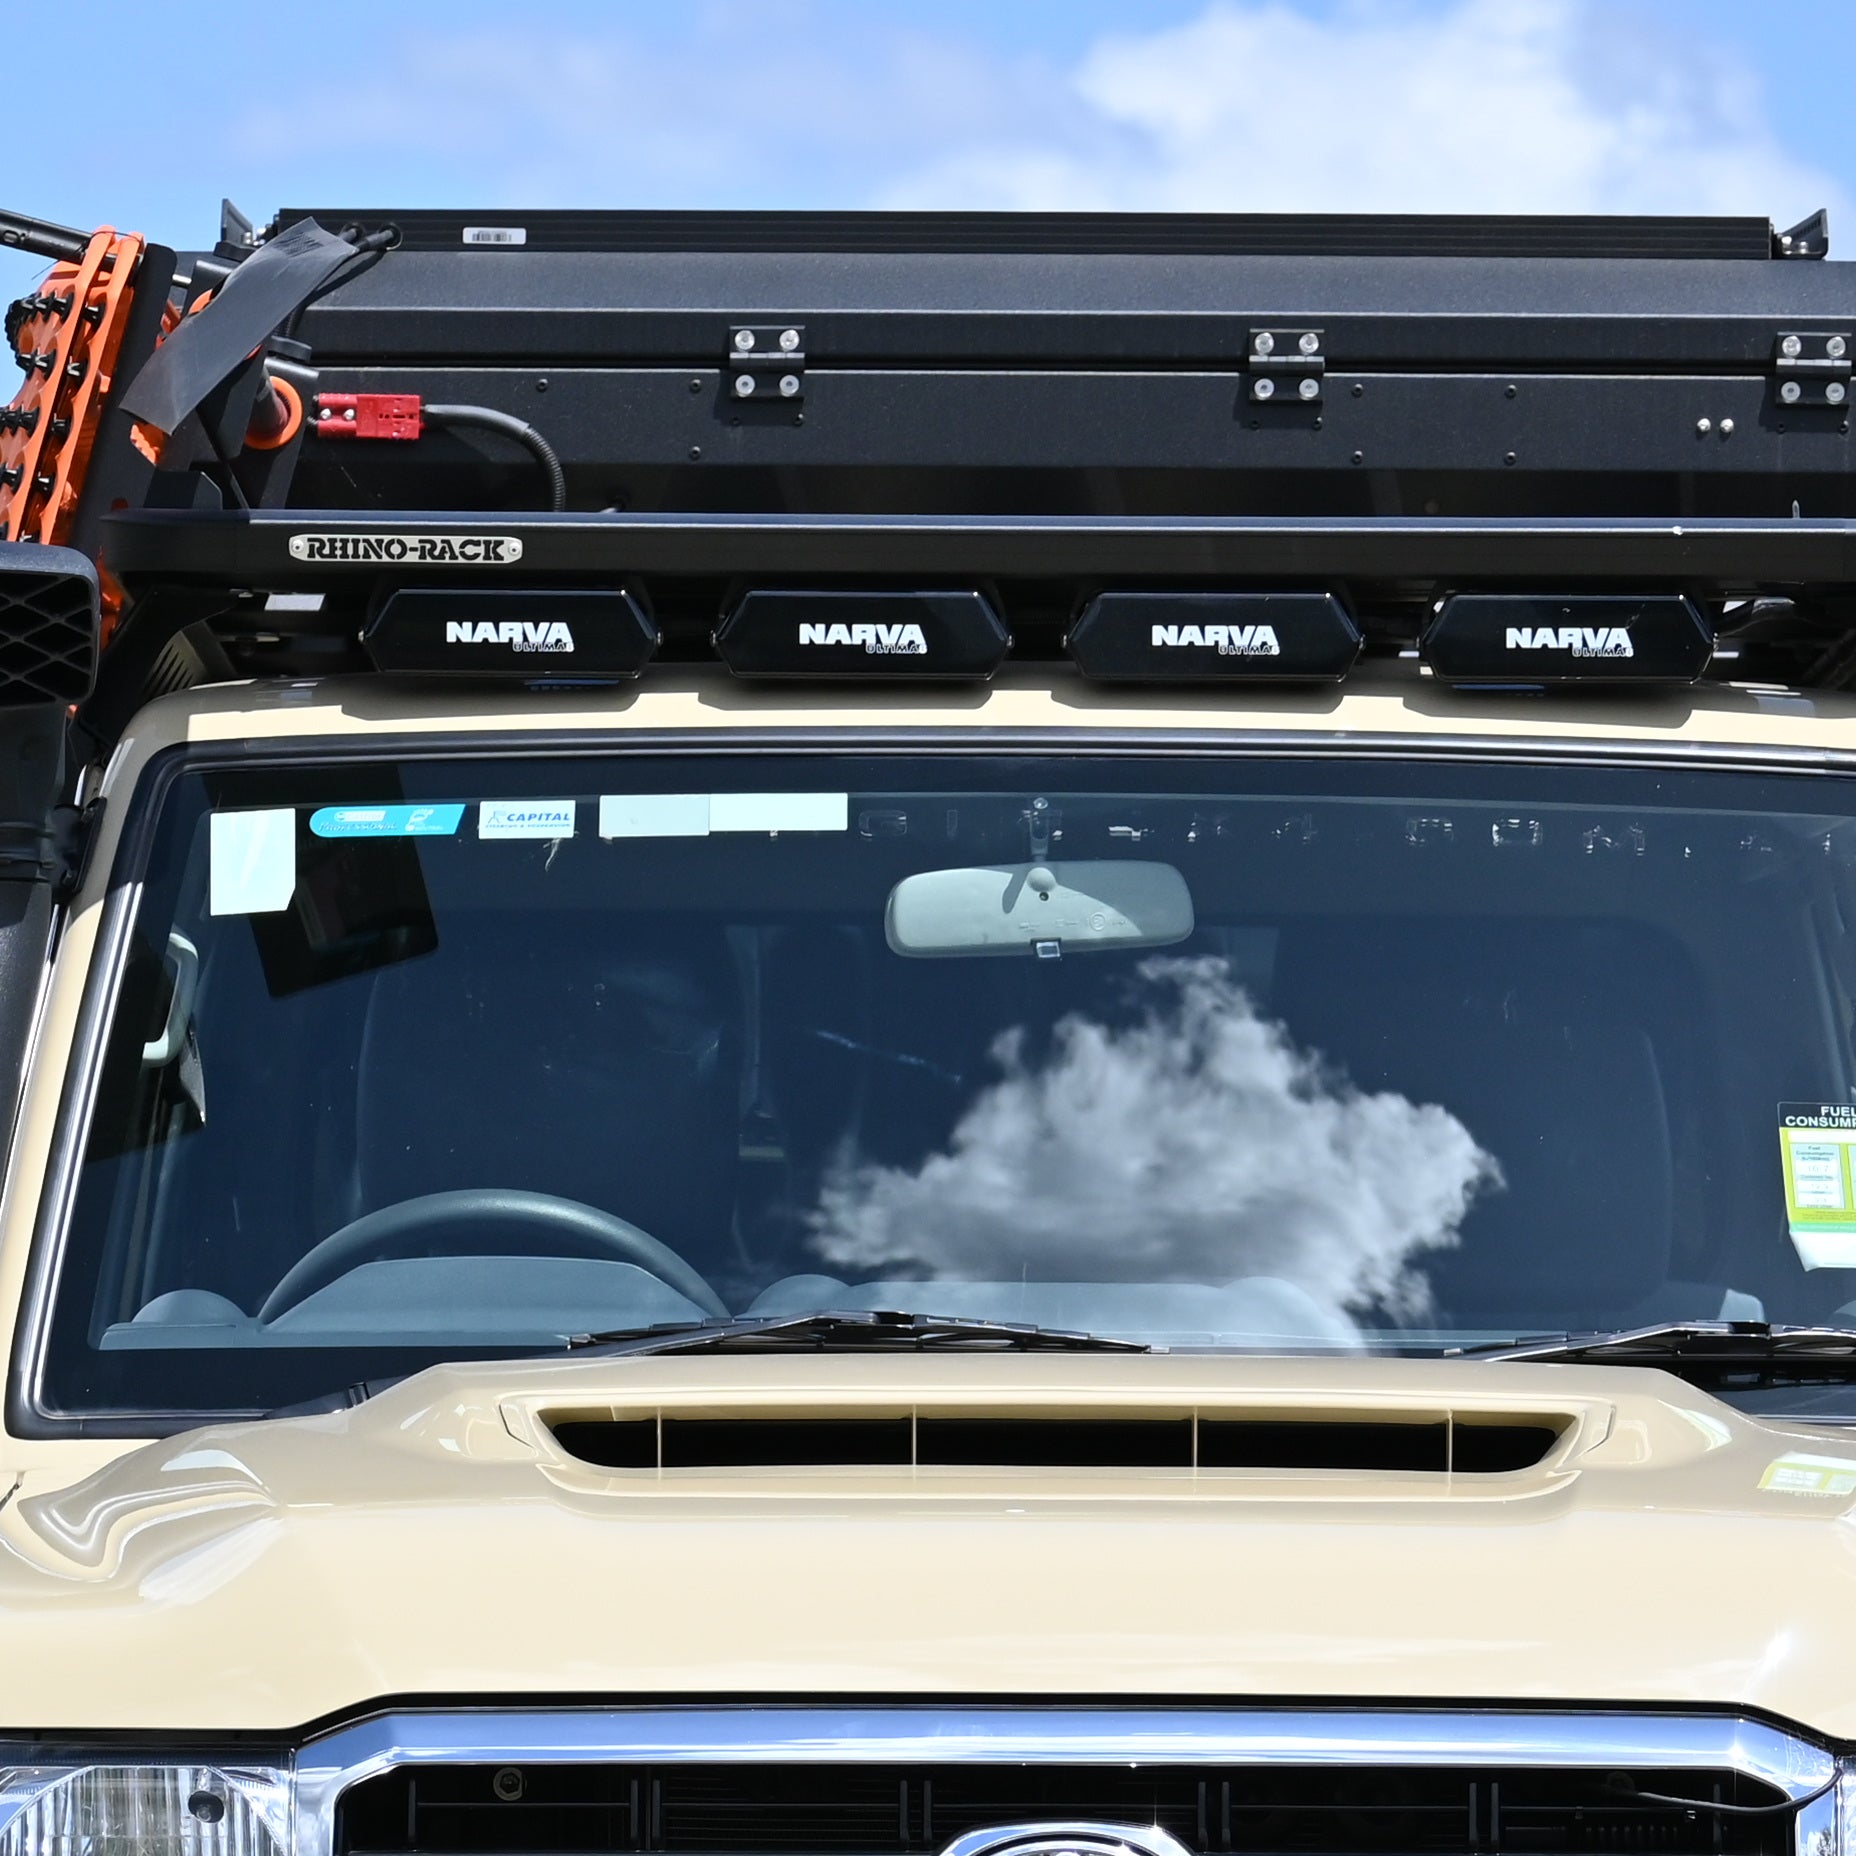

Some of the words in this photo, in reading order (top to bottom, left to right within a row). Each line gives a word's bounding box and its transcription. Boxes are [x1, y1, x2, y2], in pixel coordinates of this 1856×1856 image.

[307, 537, 505, 561] RHINO-RACK
[446, 621, 573, 643] NARVA
[799, 623, 926, 645] NARVA
[1151, 625, 1279, 646] NARVA
[1505, 627, 1632, 649] NARVA
[506, 812, 571, 822] CAPITAL
